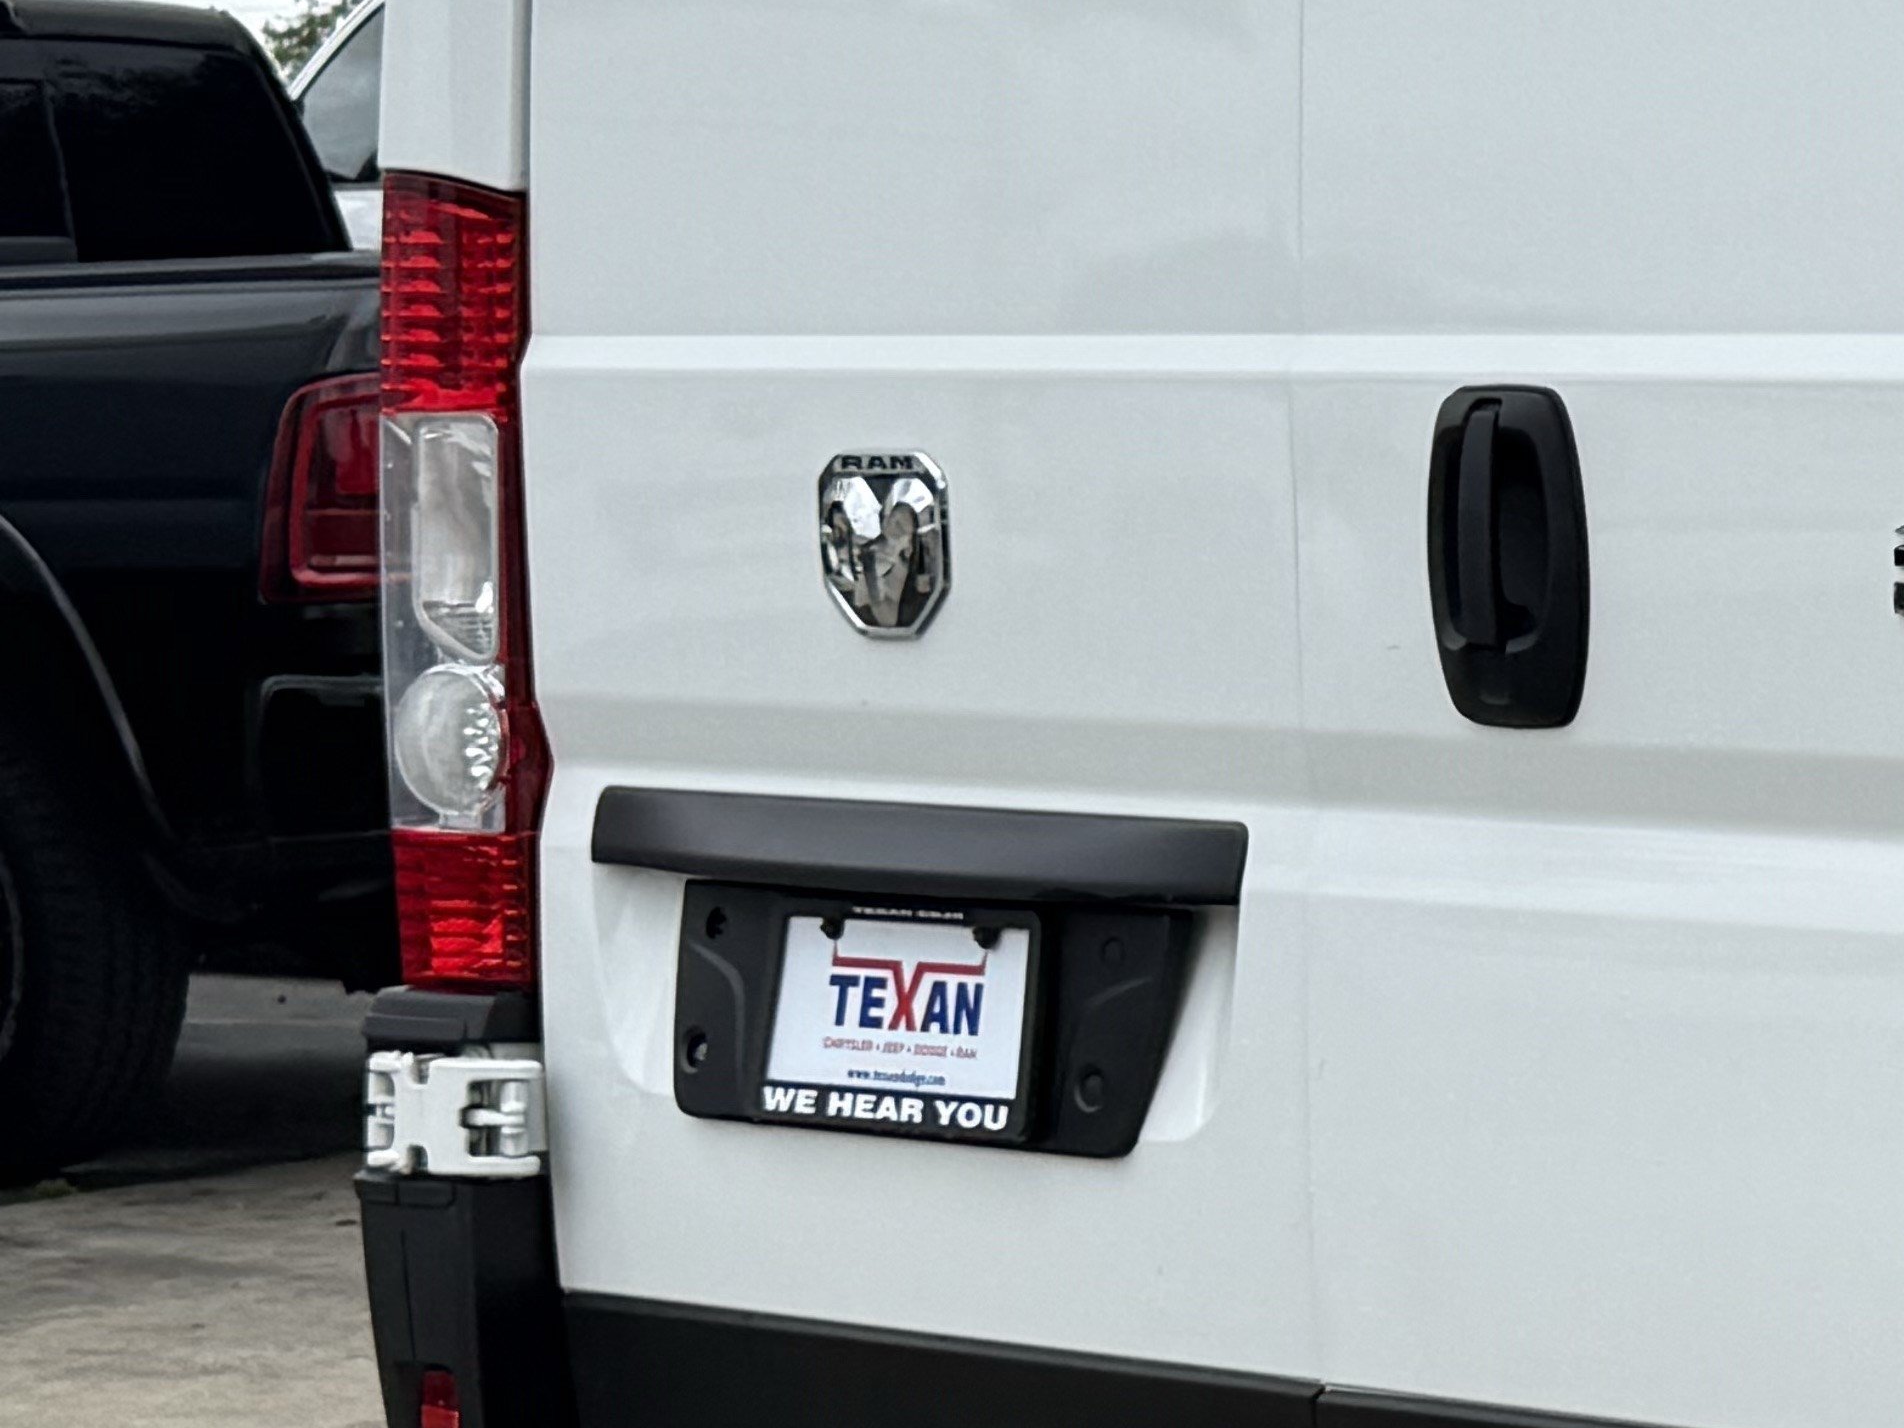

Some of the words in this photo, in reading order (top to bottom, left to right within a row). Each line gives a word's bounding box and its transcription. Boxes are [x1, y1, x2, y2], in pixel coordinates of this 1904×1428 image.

[841, 455, 914, 471] RAM
[829, 958, 985, 1036] TEXAN
[822, 1035, 874, 1052] CHRYSLER
[763, 1085, 818, 1115] WE
[825, 1091, 925, 1124] HEAR
[934, 1099, 1009, 1131] YOU
